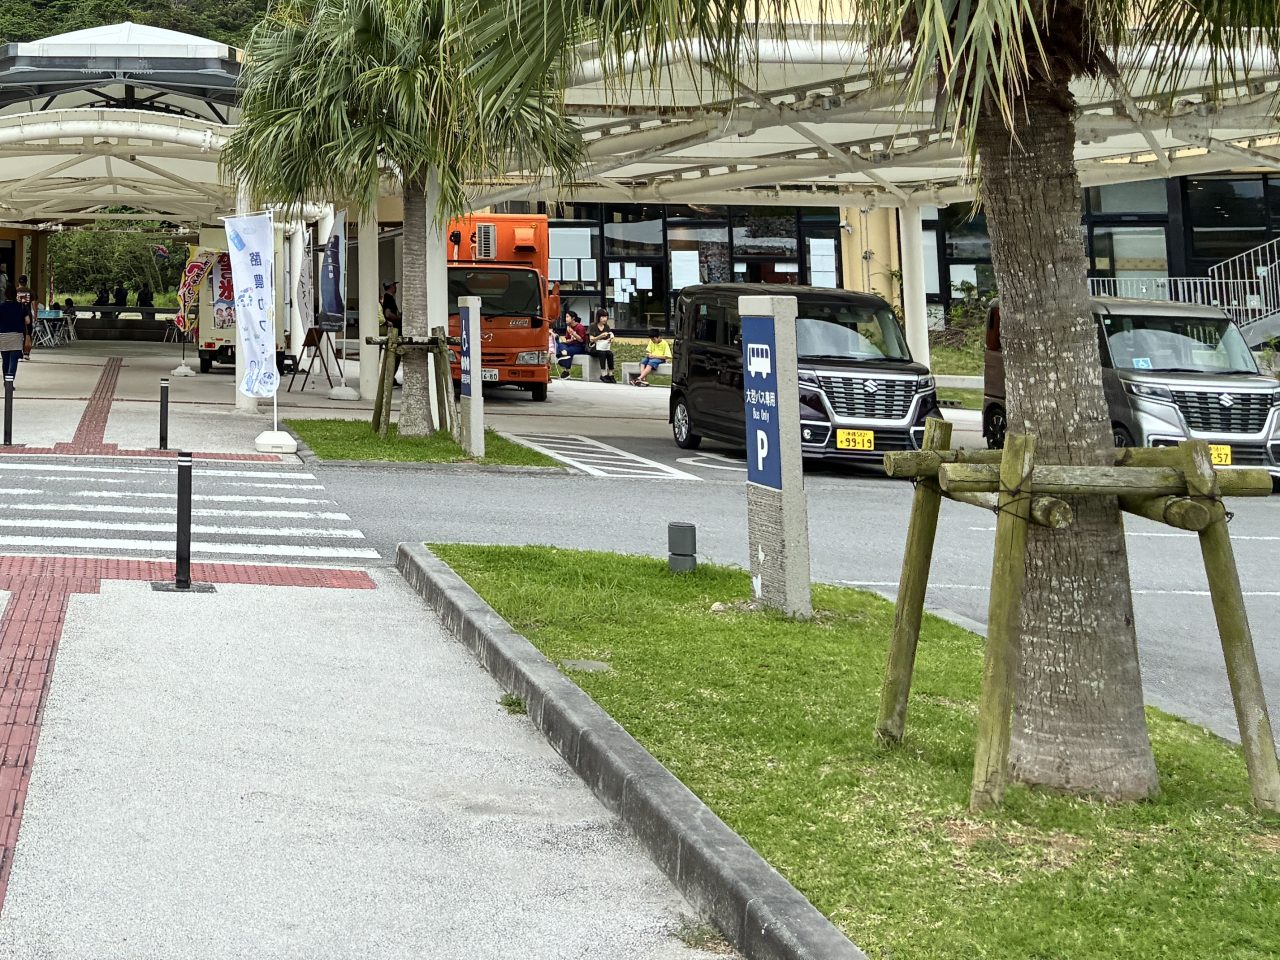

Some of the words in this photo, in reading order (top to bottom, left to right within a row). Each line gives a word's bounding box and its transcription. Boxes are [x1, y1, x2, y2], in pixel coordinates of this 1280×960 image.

[746, 389, 775, 407] 大型バス専用
[752, 408, 760, 420] Bus
[761, 408, 770, 423] Only
[756, 429, 768, 471] P
